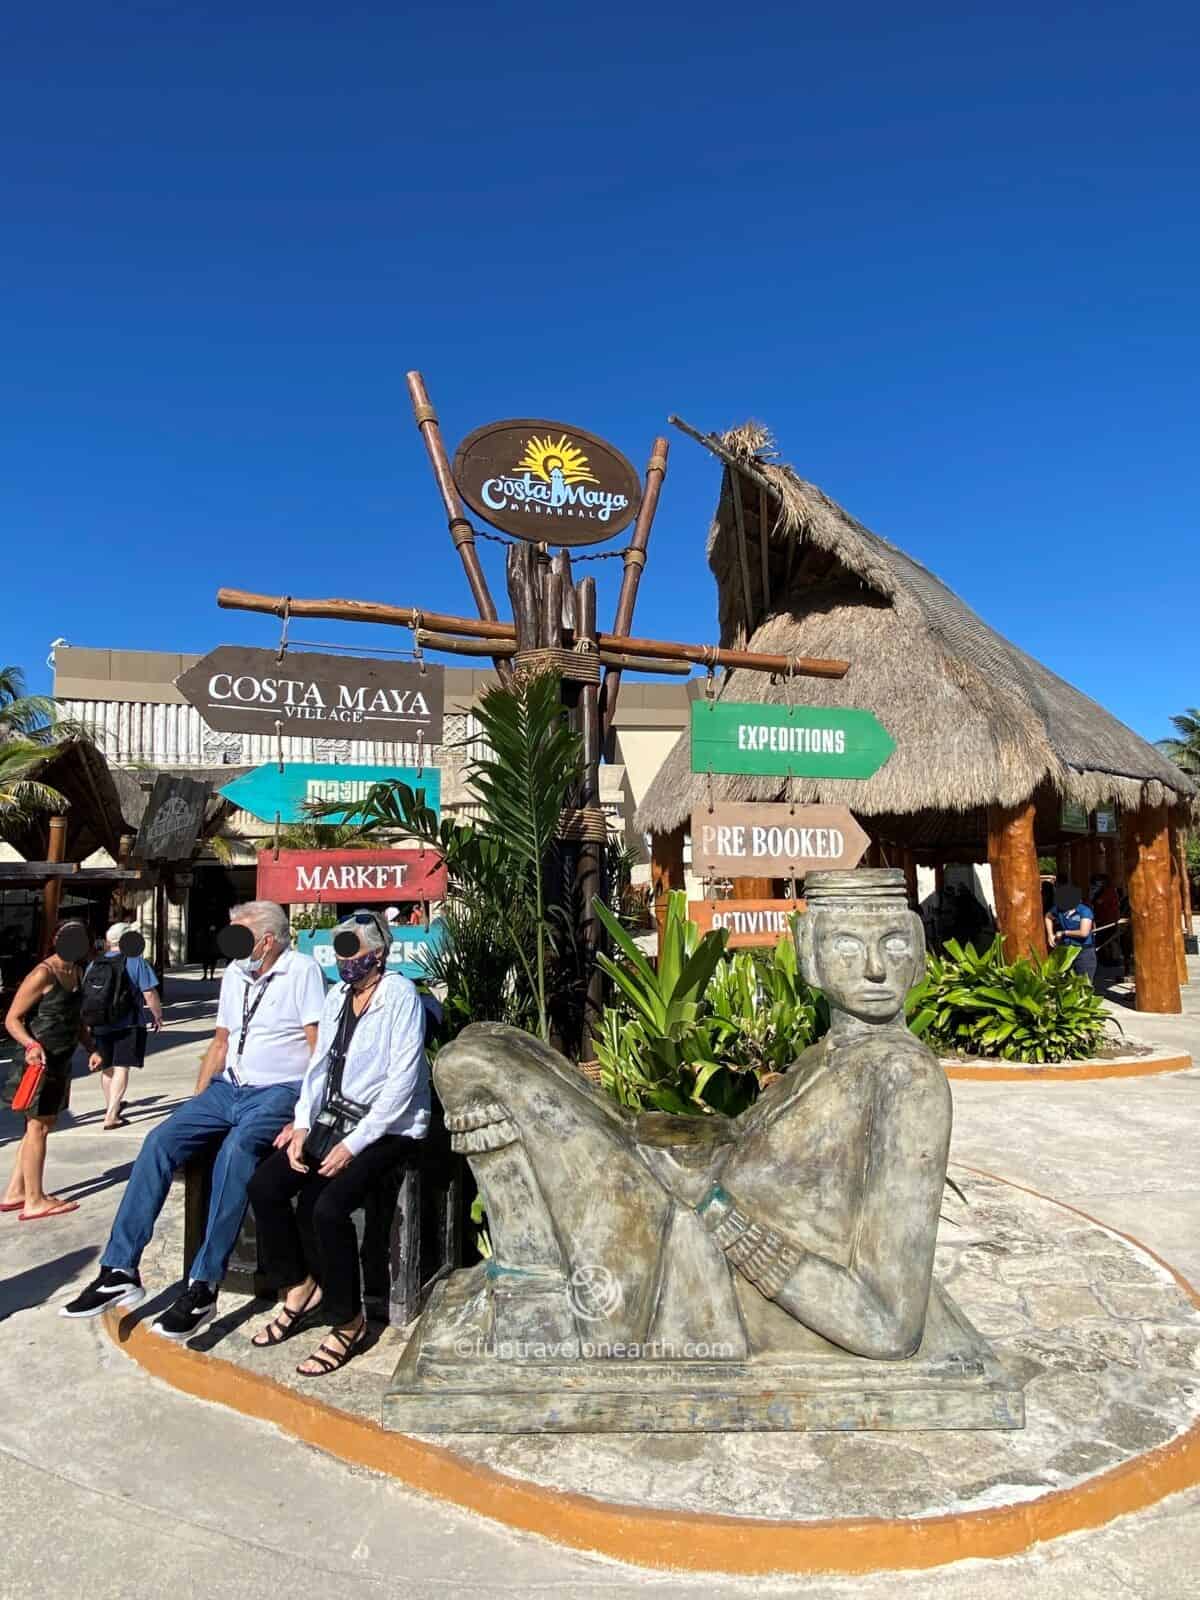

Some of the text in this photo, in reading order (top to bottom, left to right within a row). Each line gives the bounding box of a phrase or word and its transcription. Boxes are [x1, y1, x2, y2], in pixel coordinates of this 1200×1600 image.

[481, 472, 629, 521] Costa Maya
[208, 673, 431, 715] COSTA MAYA
[284, 706, 364, 723] VILLAGE
[738, 725, 845, 754] EXPEDITIONS
[702, 825, 844, 858] PRE BOOKED
[295, 864, 408, 891] MARKET
